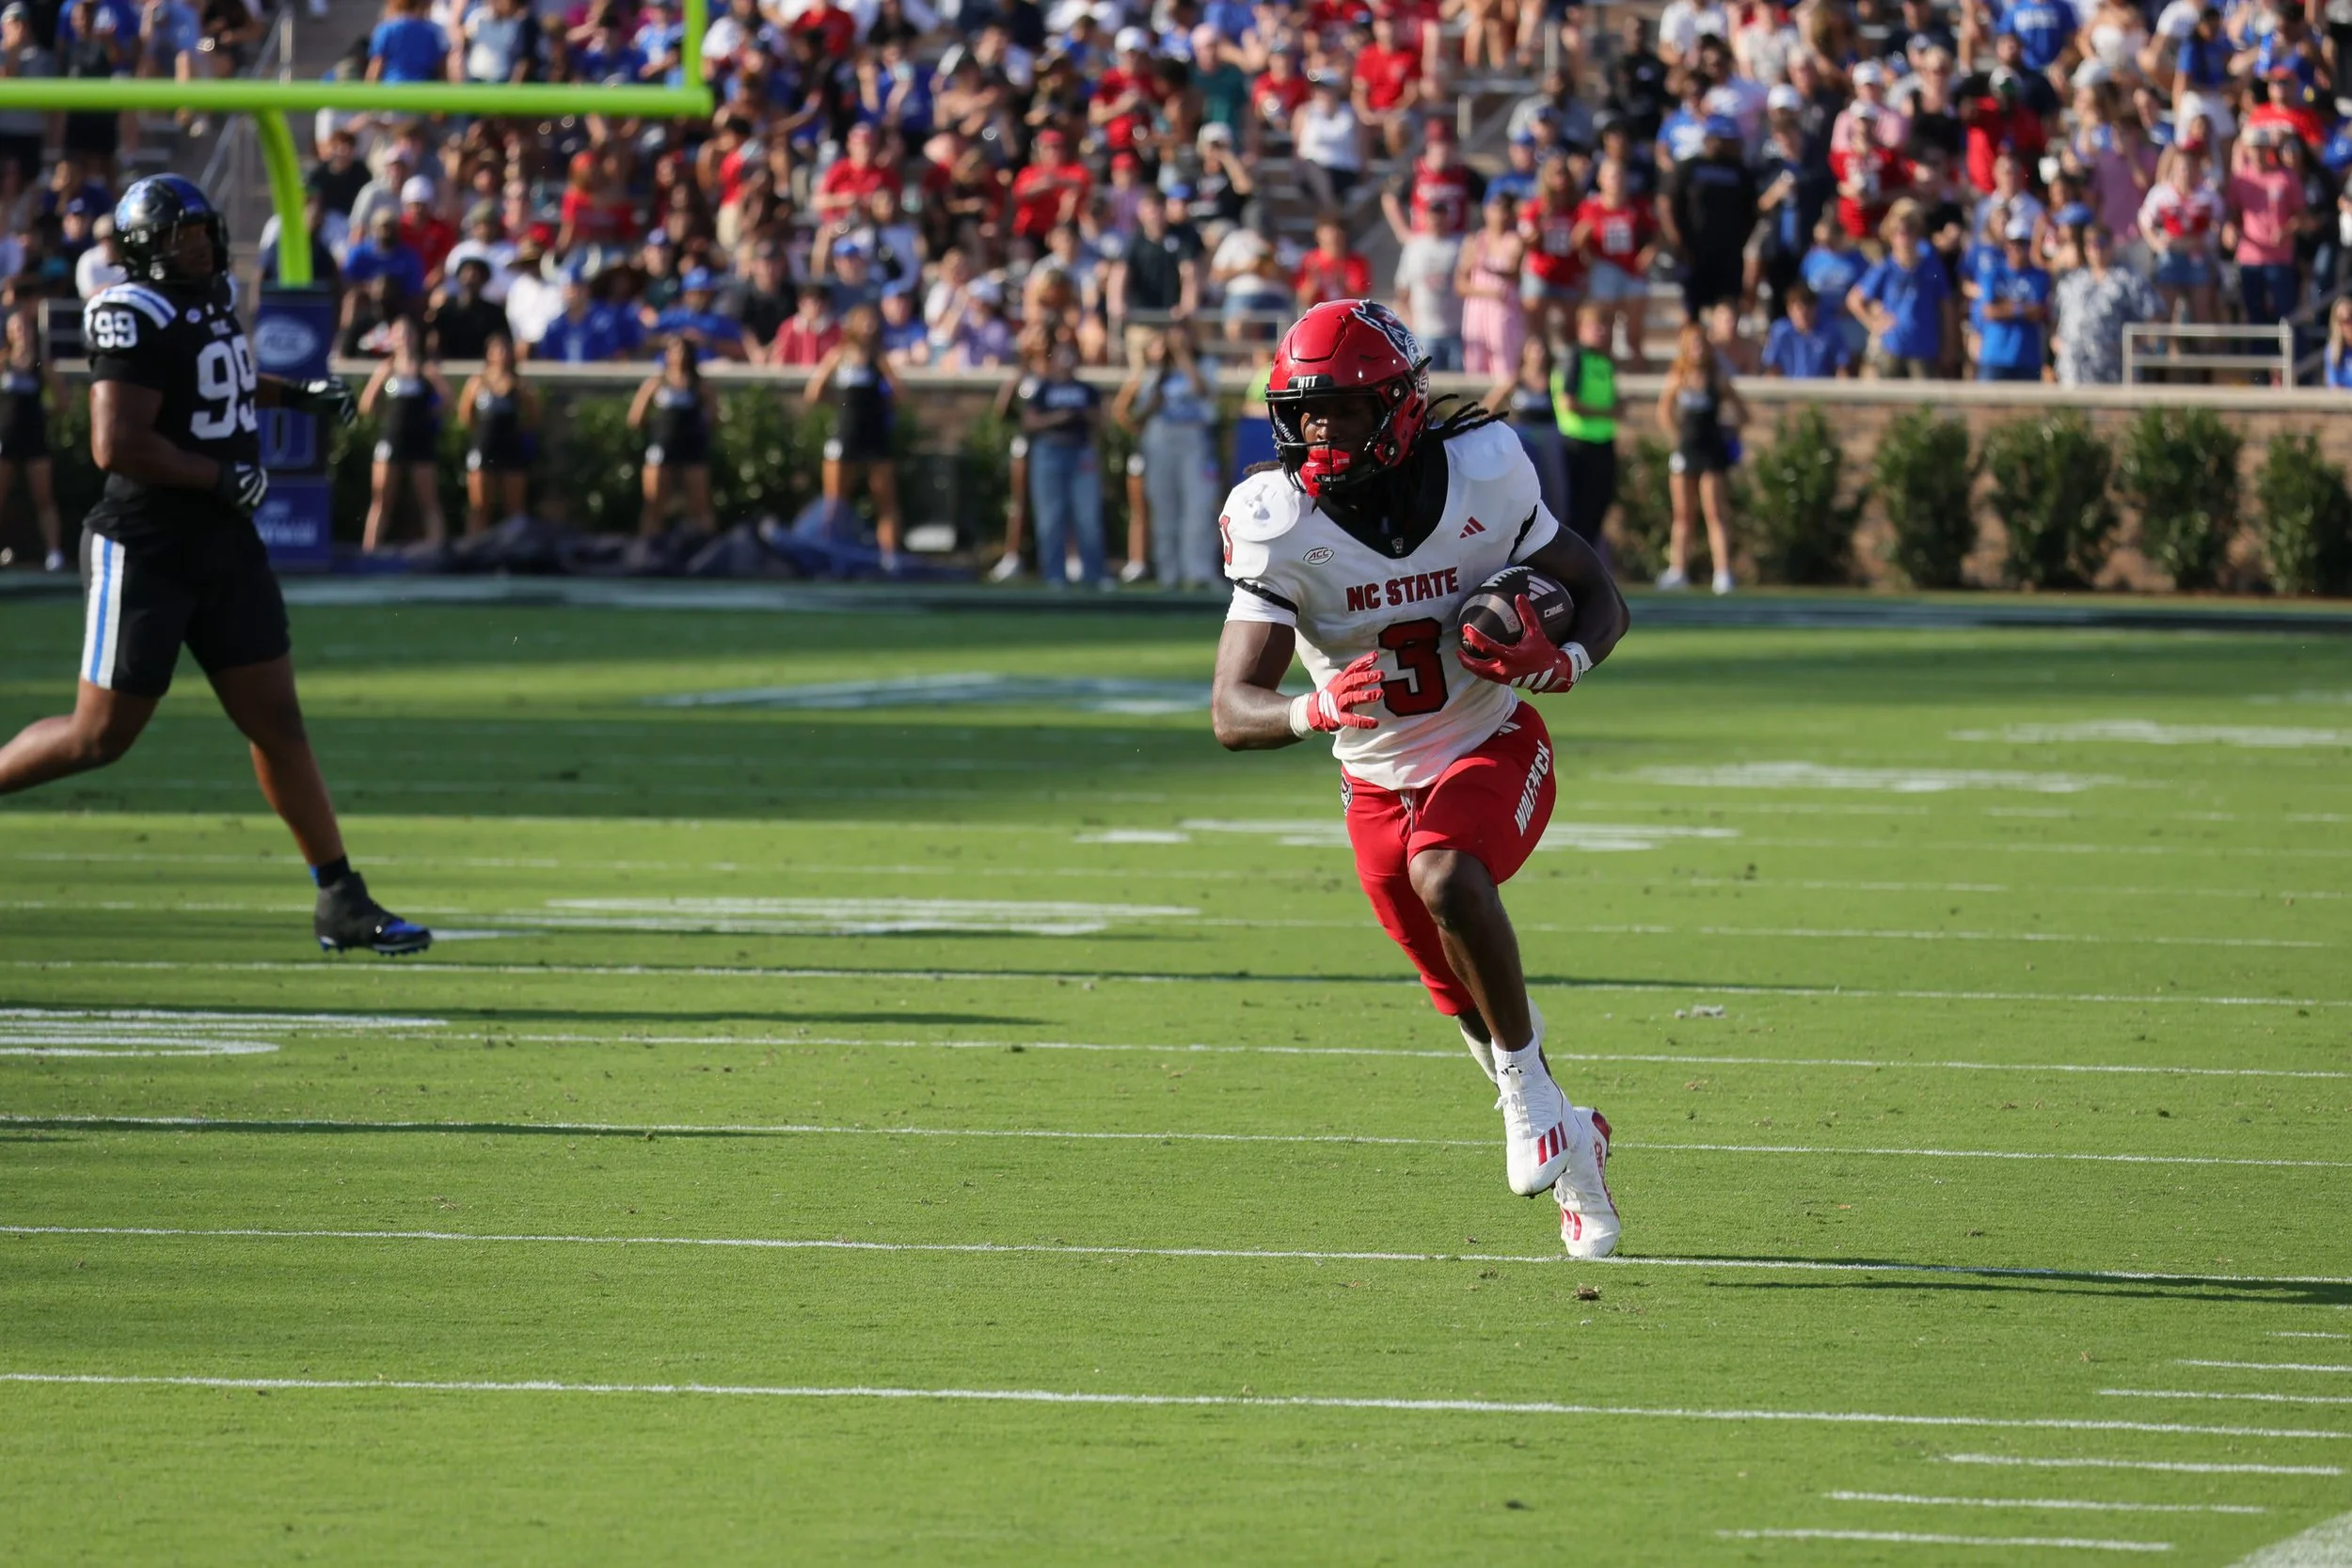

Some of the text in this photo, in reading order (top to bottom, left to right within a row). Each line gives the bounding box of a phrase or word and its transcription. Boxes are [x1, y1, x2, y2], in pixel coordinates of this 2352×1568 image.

[95, 310, 137, 348] 99
[190, 335, 257, 440] 99
[1297, 376, 1317, 388] HTT
[1309, 549, 1329, 560] ACC
[1346, 566, 1458, 611] NC STATE
[1544, 603, 1565, 618] DIME
[1378, 617, 1449, 717] 3
[1514, 738, 1550, 837] WOLFPACK
